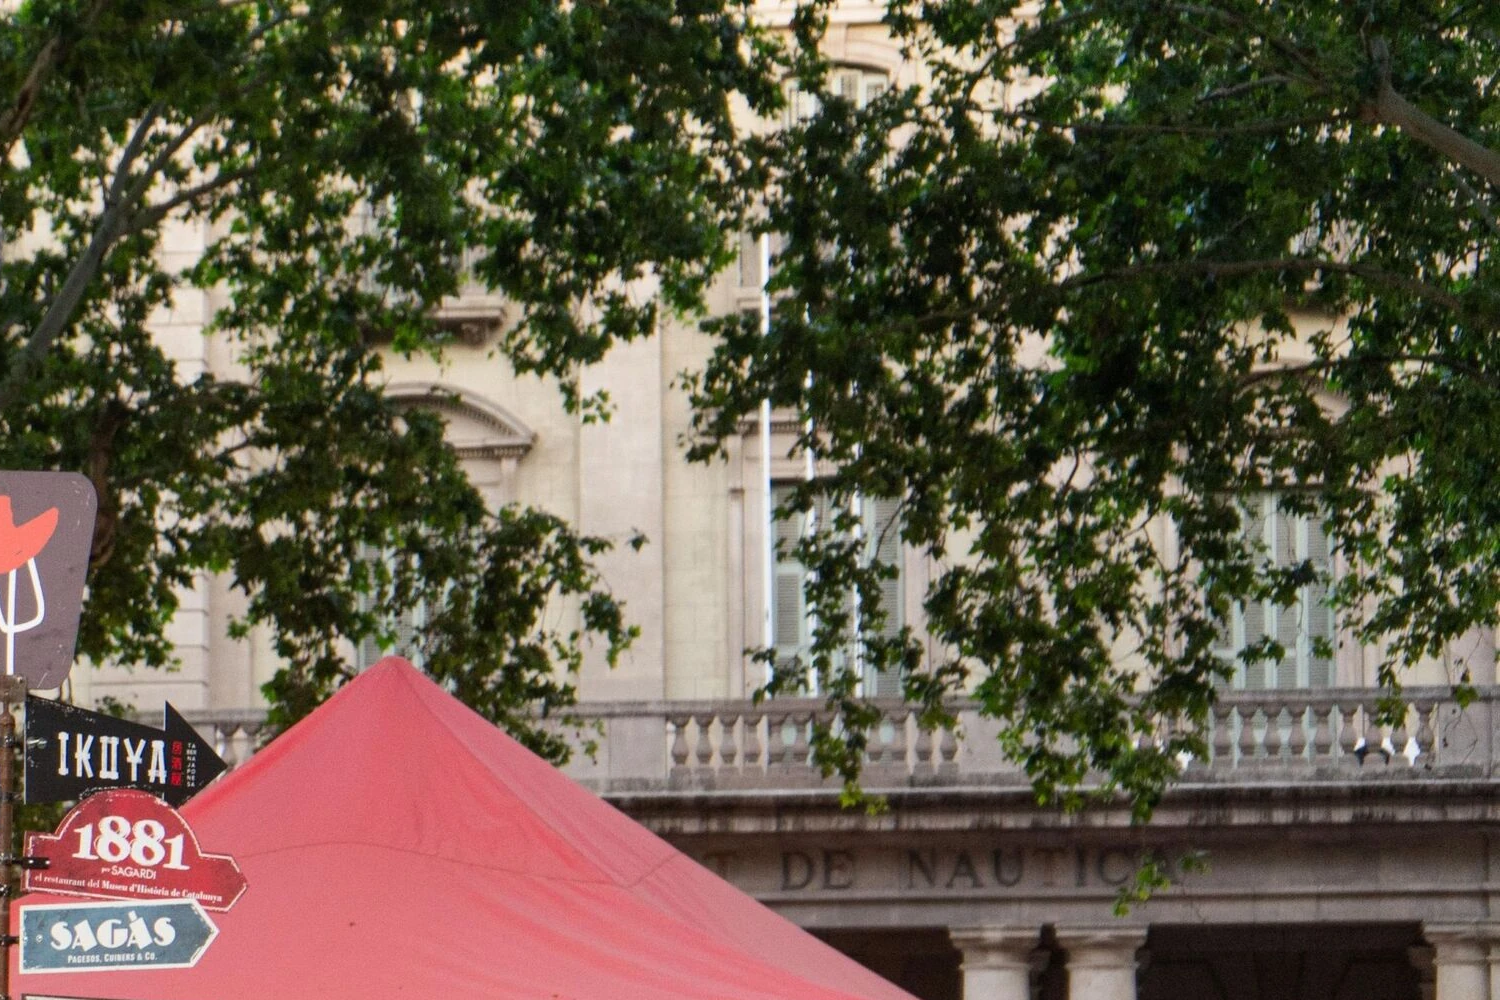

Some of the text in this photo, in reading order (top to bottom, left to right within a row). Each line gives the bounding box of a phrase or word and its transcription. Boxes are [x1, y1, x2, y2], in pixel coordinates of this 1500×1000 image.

[72, 816, 190, 870] 1881
[34, 873, 43, 882] el
[44, 875, 86, 887] restaurant
[87, 878, 100, 888] del
[102, 880, 128, 892] Museu
[171, 886, 181, 898] de
[111, 865, 156, 879] SAGARDI
[779, 849, 855, 891] DE
[50, 910, 176, 952] SAGÀS
[137, 953, 142, 961] &
